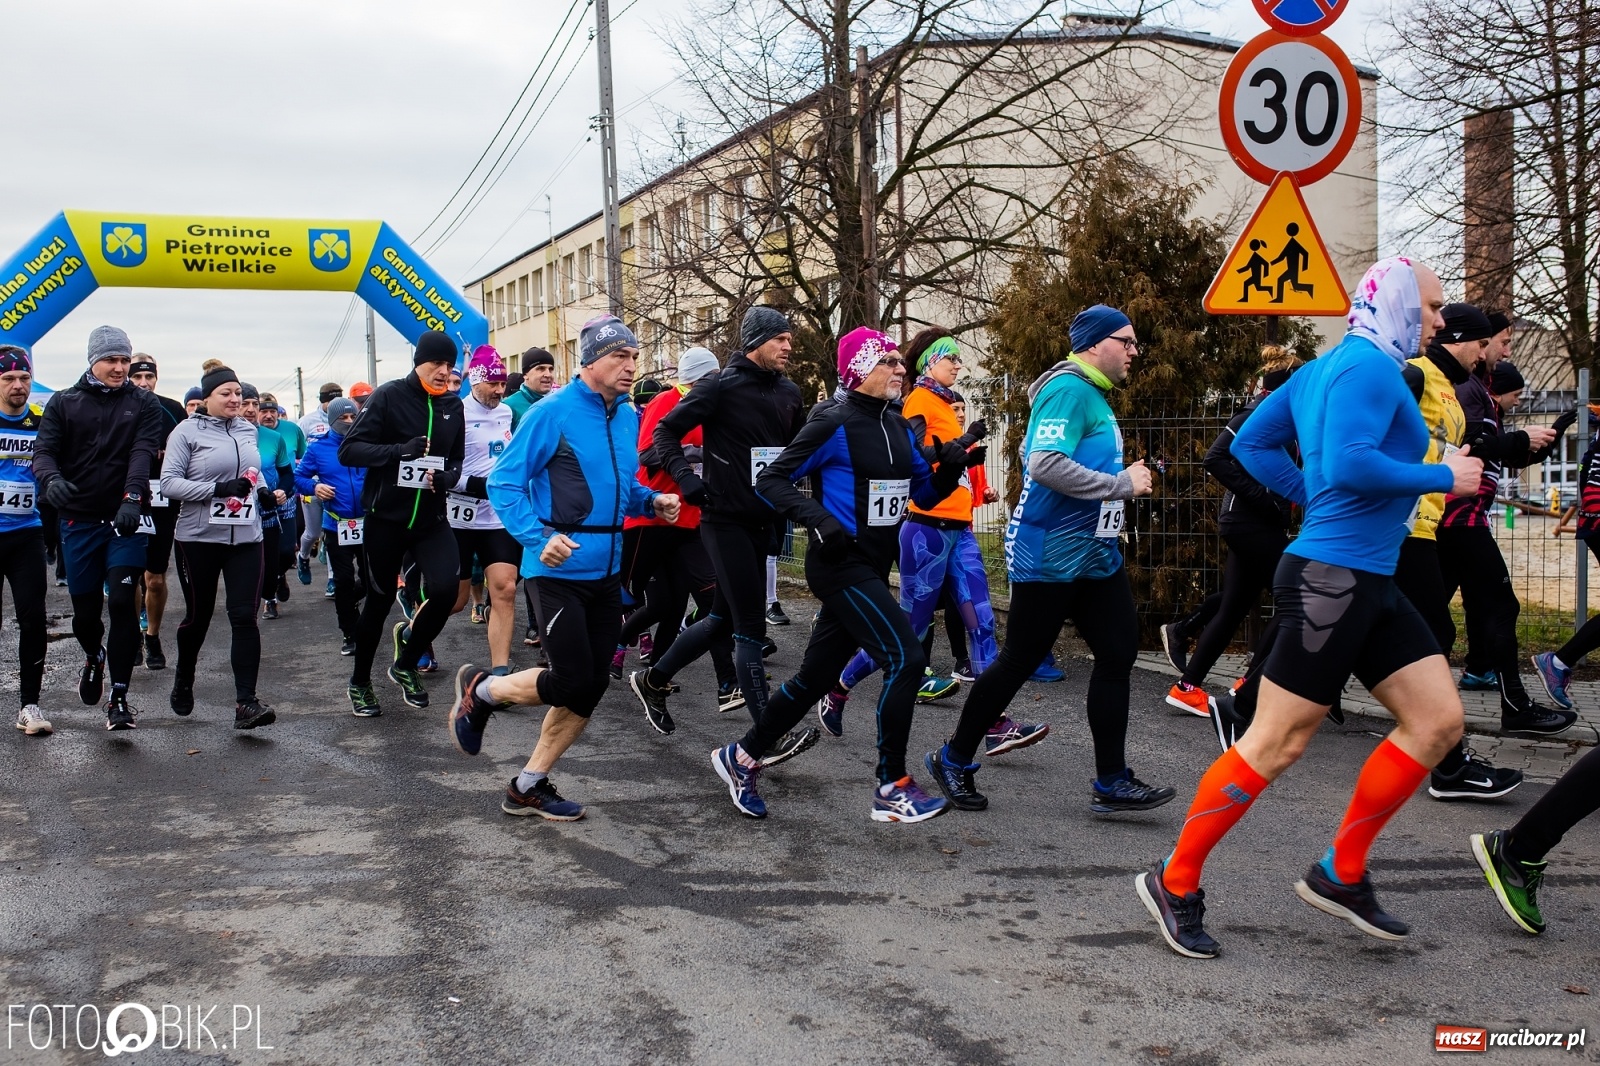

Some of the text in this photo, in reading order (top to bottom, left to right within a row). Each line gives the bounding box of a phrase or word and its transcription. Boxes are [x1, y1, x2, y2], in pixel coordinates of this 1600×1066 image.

[1243, 67, 1340, 147] 30
[186, 224, 271, 239] Gmina
[23, 235, 68, 275] ludzi
[165, 239, 294, 257] Pietrowice
[182, 258, 277, 274] Wielkie
[0, 255, 83, 331] aktywnych
[382, 247, 463, 323] Gmina ludzi
[596, 339, 627, 356] DUATHLON
[451, 504, 475, 522] 19
[873, 495, 907, 518] 187
